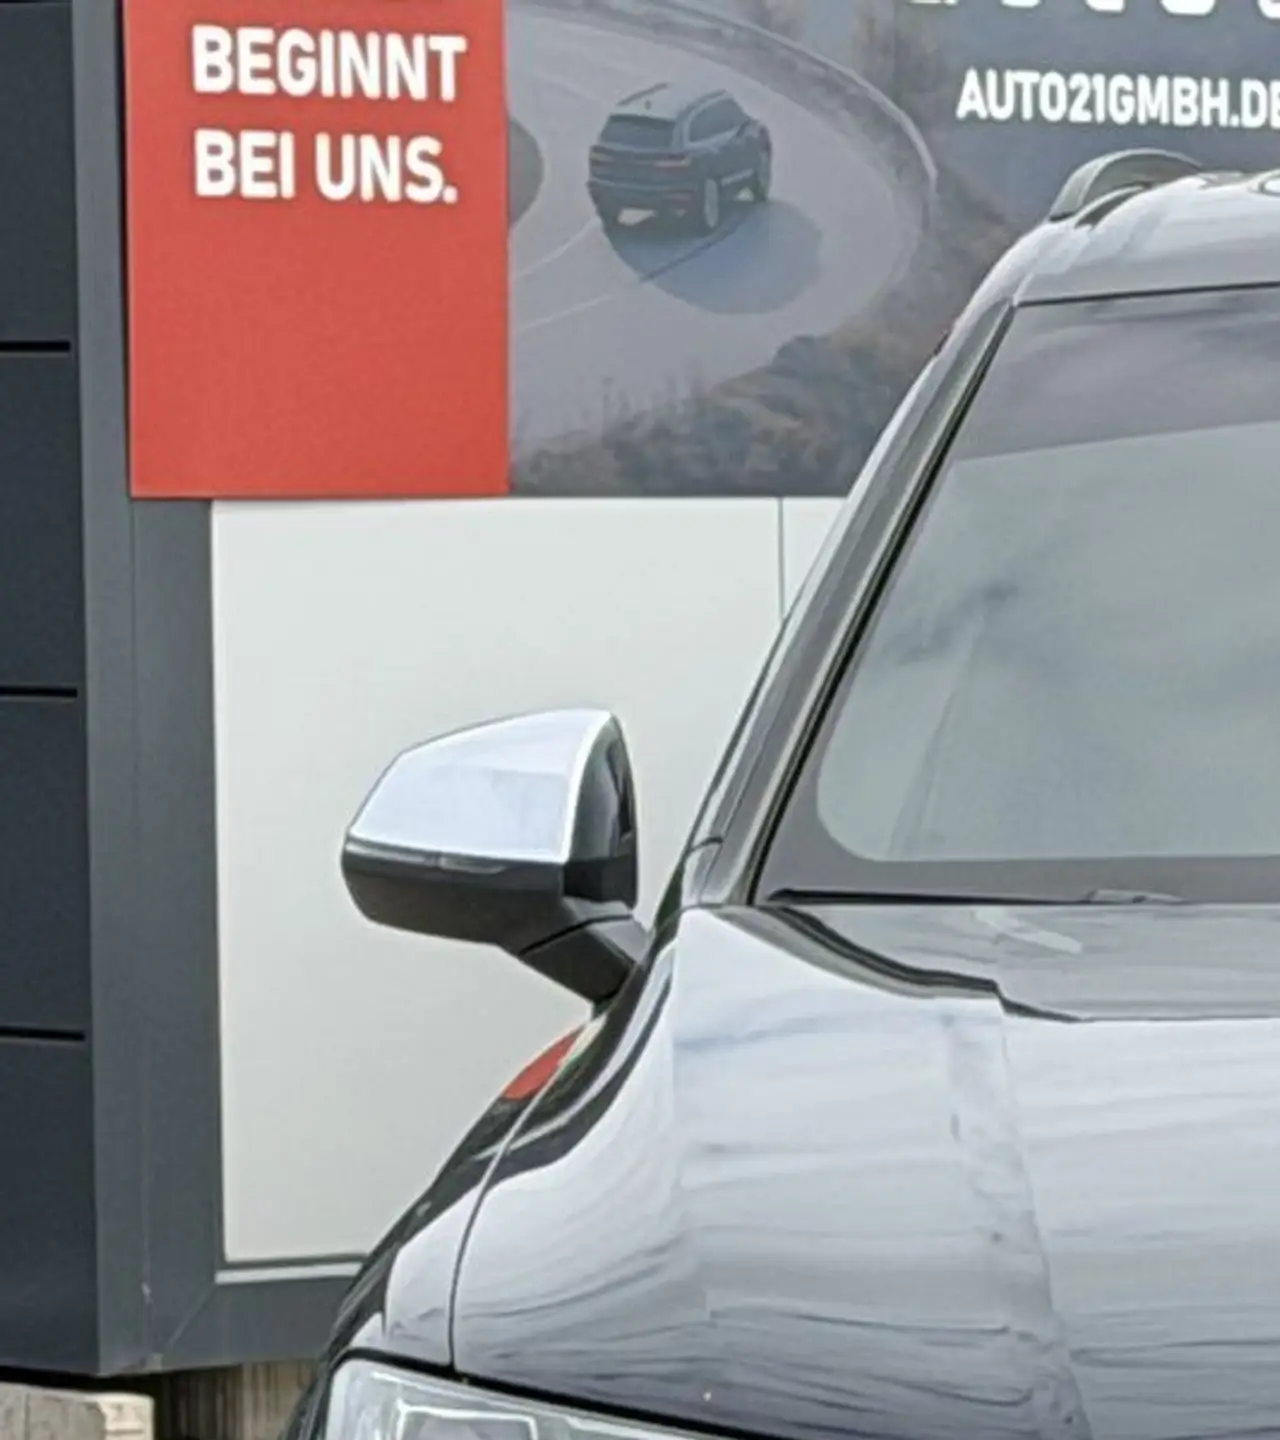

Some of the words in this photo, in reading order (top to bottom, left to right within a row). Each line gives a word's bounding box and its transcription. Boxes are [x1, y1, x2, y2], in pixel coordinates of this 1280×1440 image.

[192, 24, 468, 102] BEGINNT
[193, 127, 295, 199] BEI
[314, 131, 459, 204] UNS.
